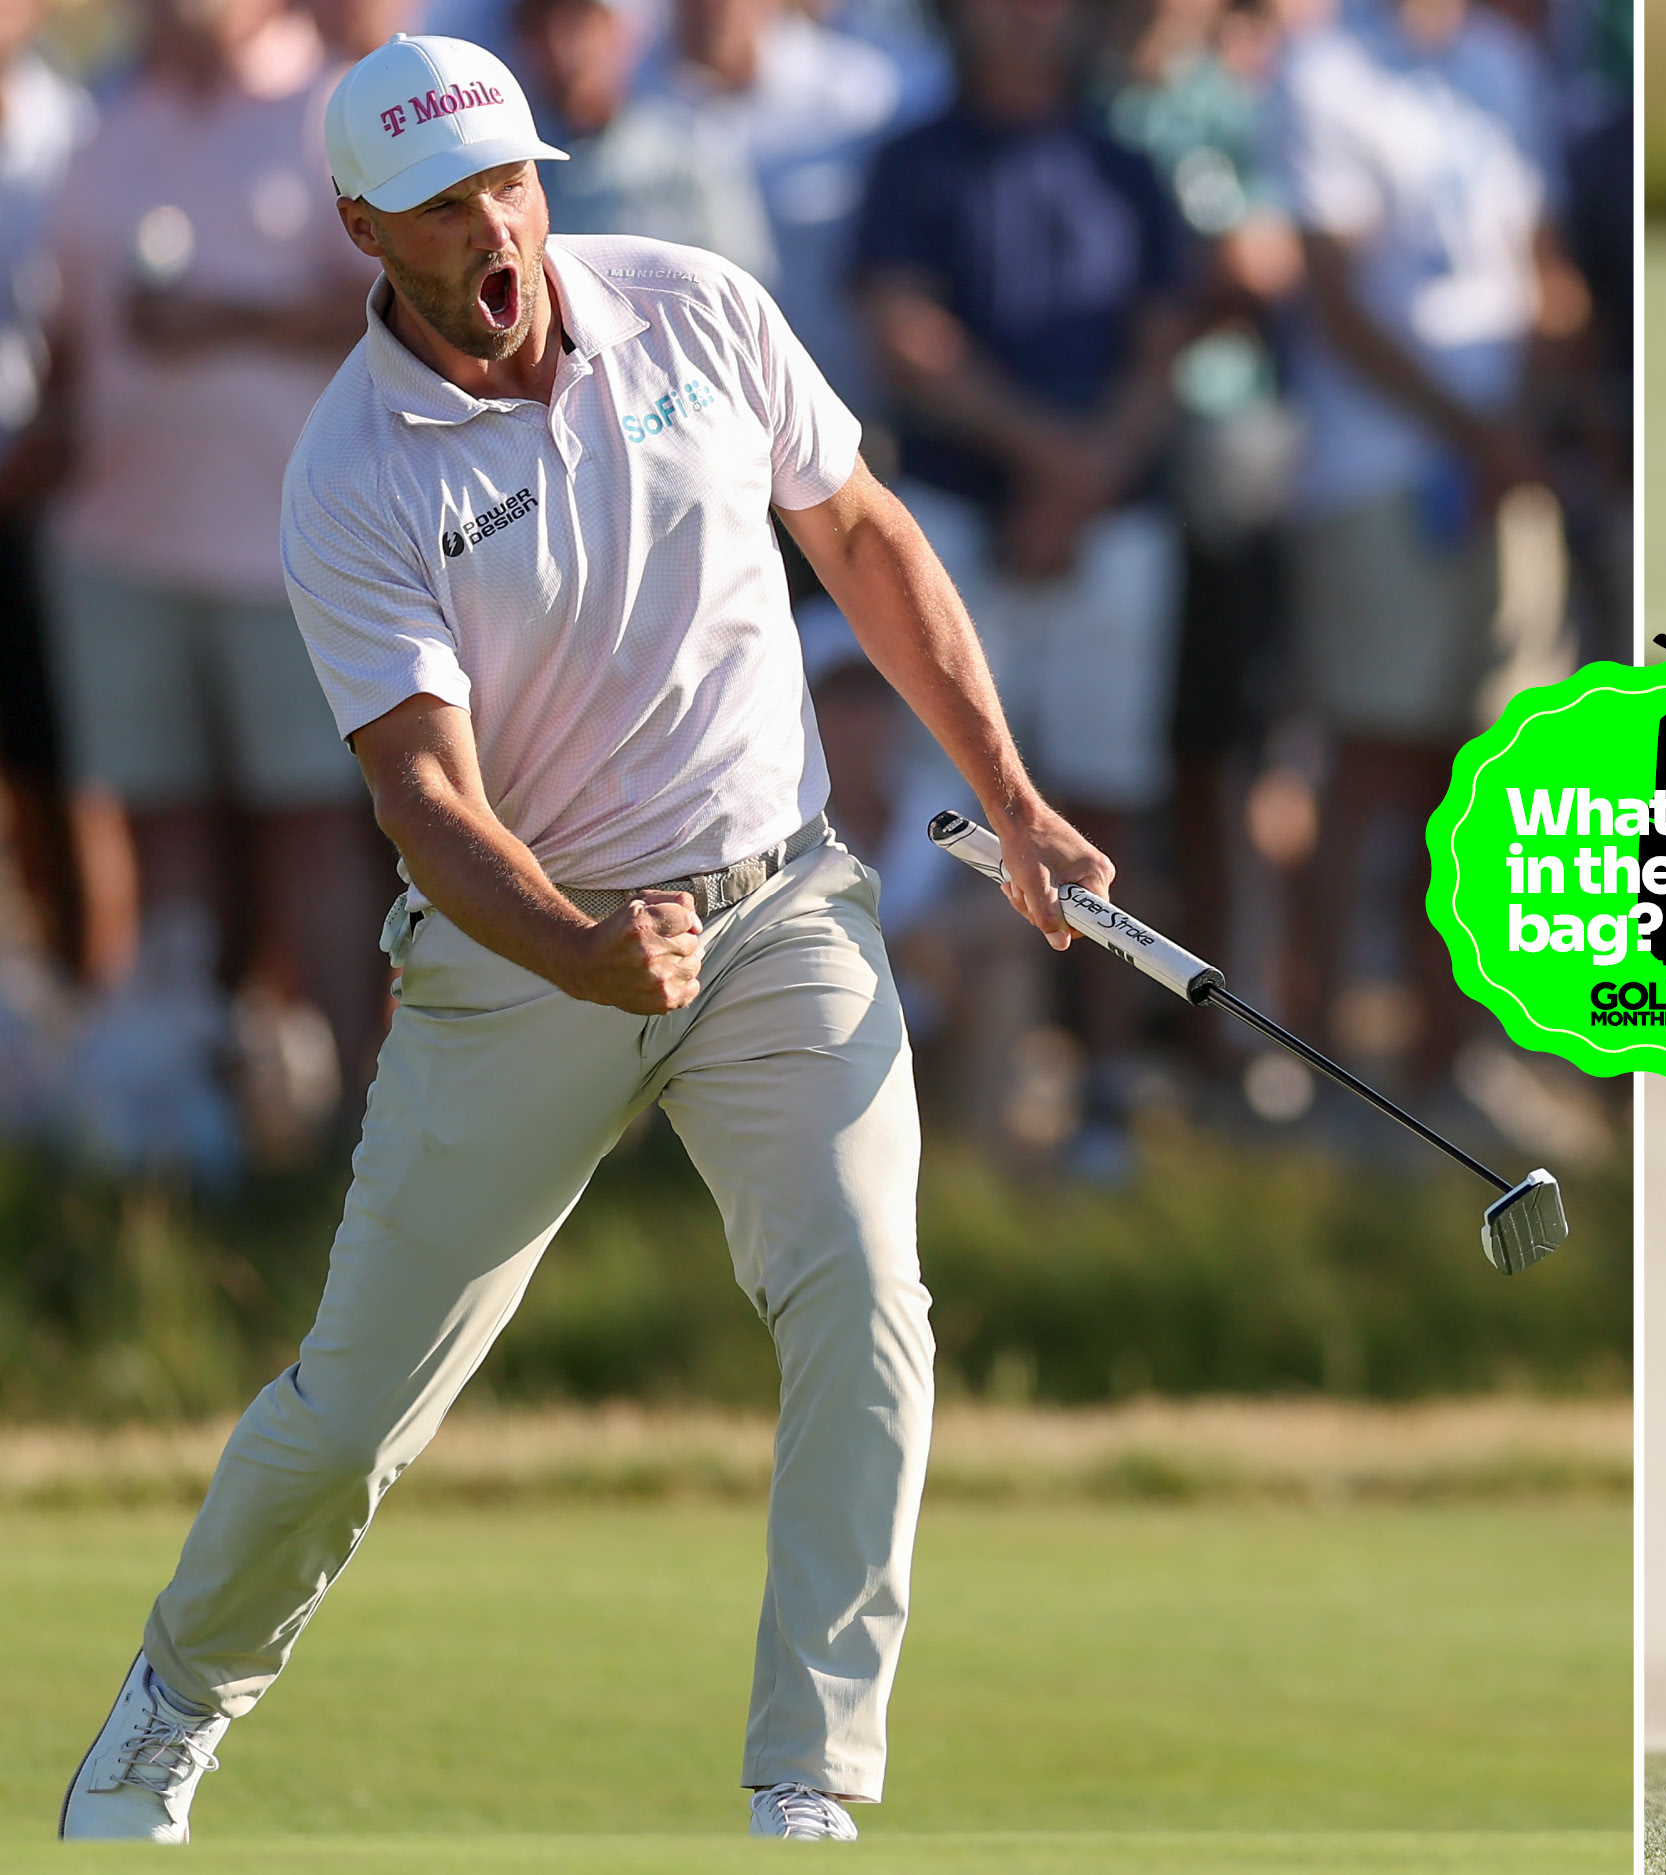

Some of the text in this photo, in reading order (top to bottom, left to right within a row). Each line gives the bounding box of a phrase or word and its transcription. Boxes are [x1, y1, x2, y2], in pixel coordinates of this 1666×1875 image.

[408, 81, 505, 125] Mobile
[609, 268, 701, 285] MUNICIPAL
[622, 391, 688, 443] SoFi
